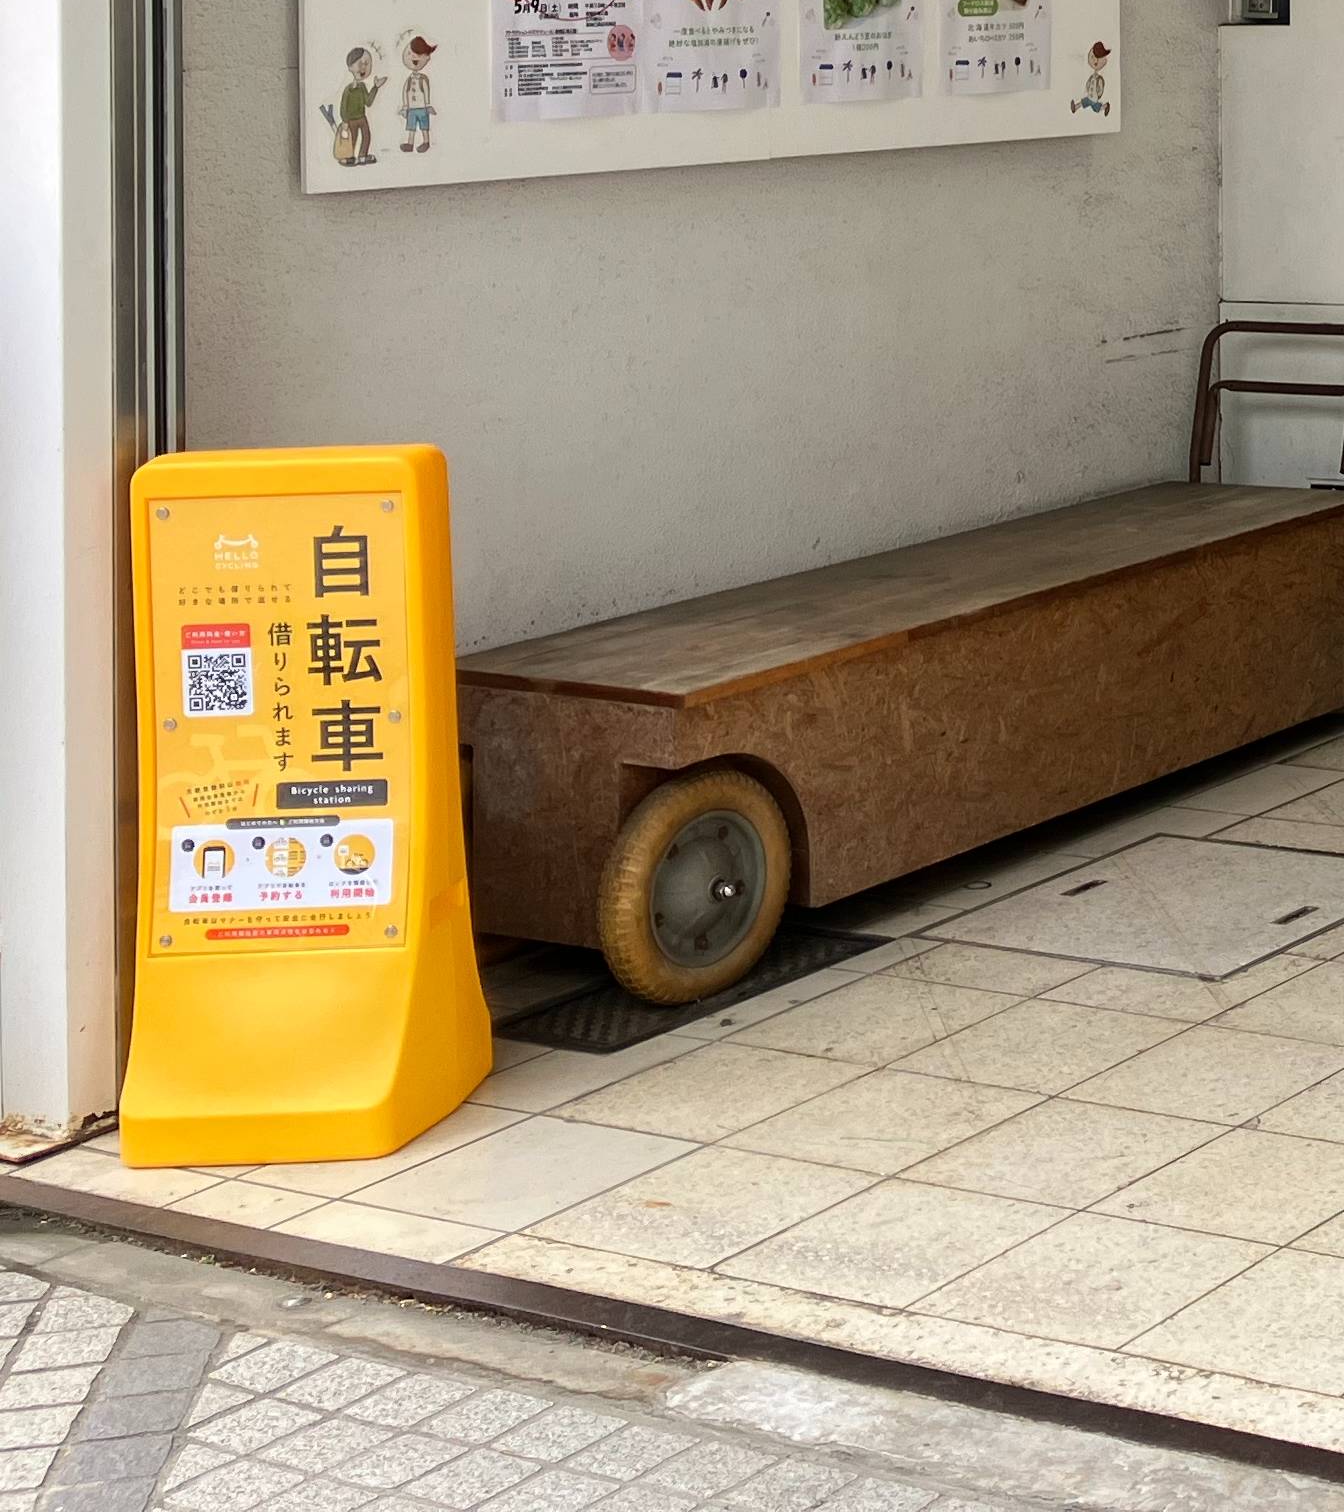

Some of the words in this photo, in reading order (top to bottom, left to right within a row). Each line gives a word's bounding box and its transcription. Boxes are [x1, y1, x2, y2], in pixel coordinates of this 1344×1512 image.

[214, 551, 258, 561] HELLO
[306, 524, 385, 773] 自転車
[268, 621, 294, 773] 借りられます
[290, 785, 329, 797] Bicycle
[335, 784, 374, 796] sharing
[313, 795, 351, 805] station
[258, 890, 303, 902] 予約する
